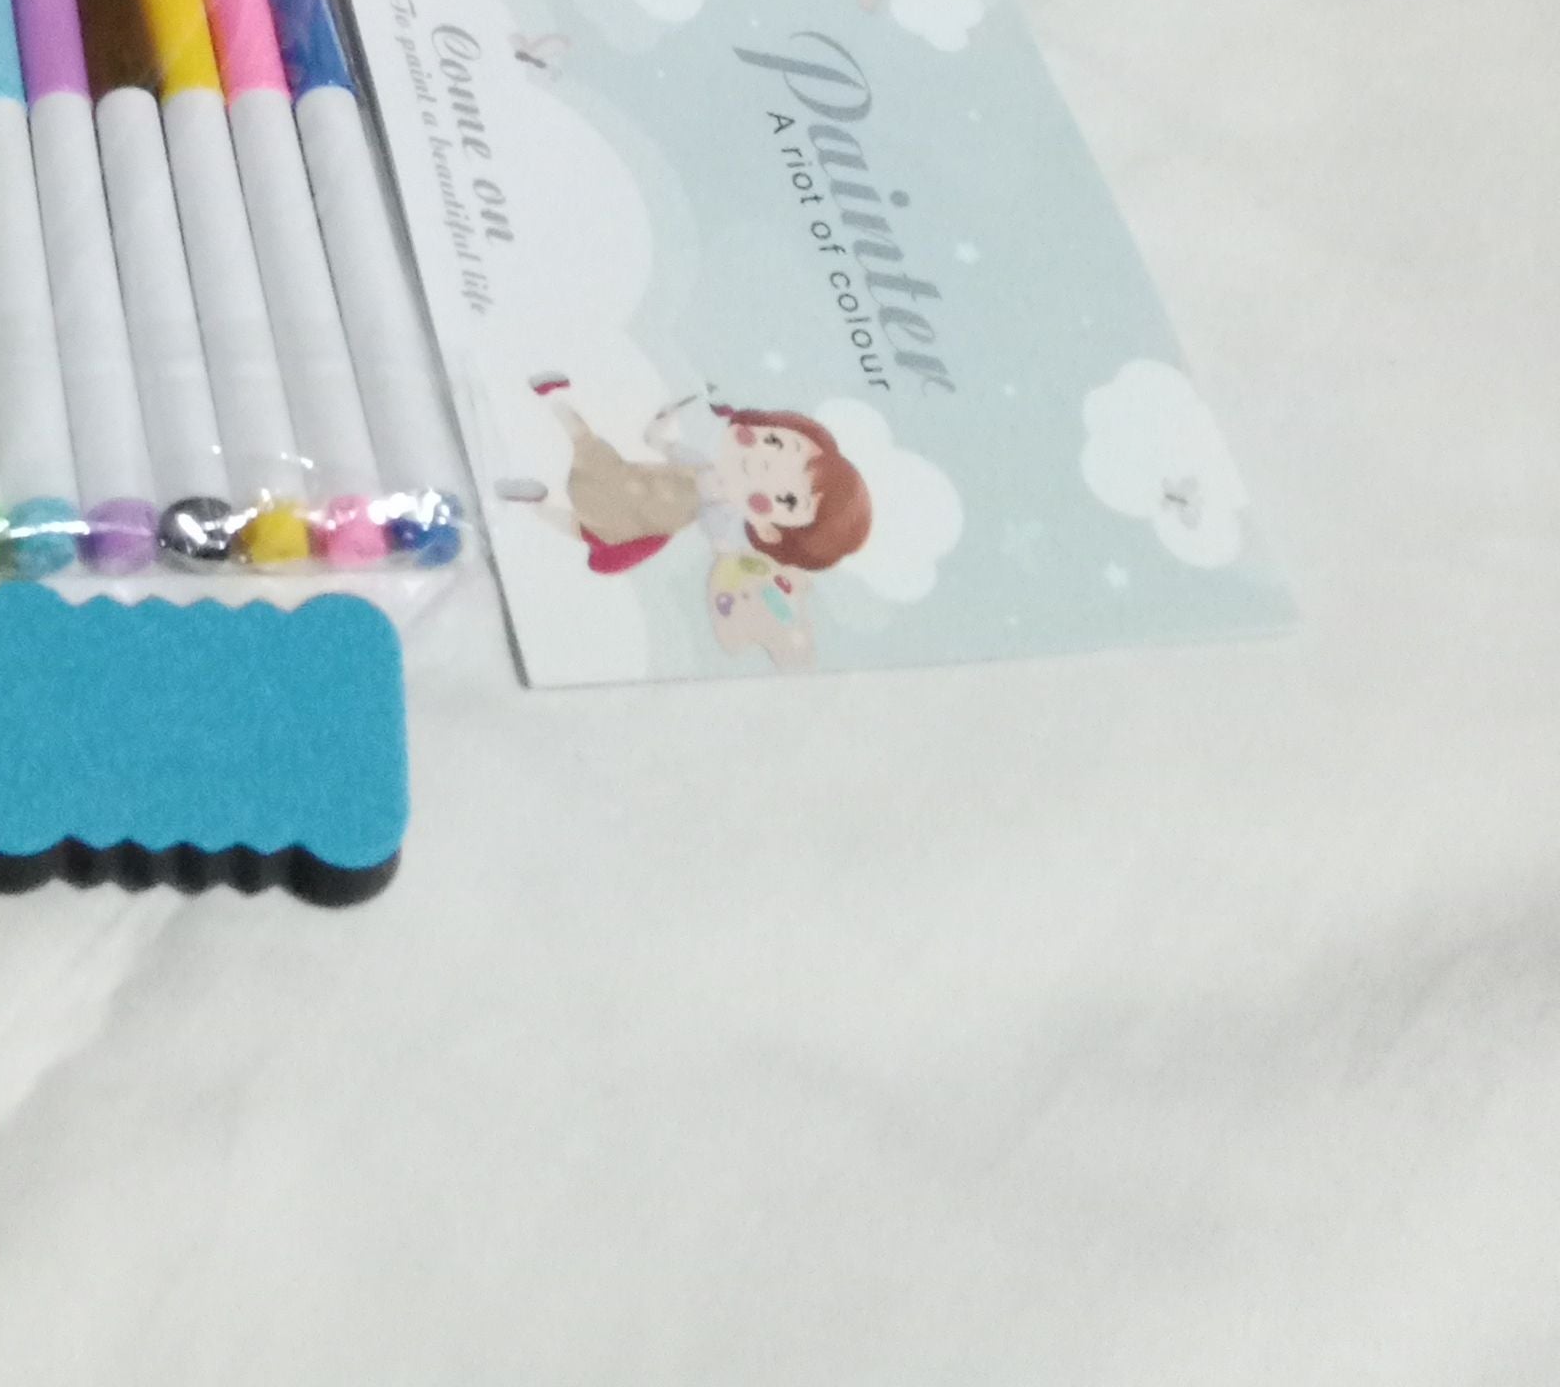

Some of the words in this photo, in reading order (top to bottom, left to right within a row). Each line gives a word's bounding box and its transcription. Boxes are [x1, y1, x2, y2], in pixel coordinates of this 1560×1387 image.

[394, 34, 438, 104] paint
[420, 110, 439, 128] a
[431, 23, 492, 161] Come
[472, 178, 515, 242] on
[428, 135, 483, 263] beautiful
[731, 30, 956, 397] Painter
[766, 111, 796, 135] A
[781, 145, 825, 206] riot
[810, 220, 846, 257] of
[829, 271, 891, 392] colour
[460, 269, 495, 317] life
